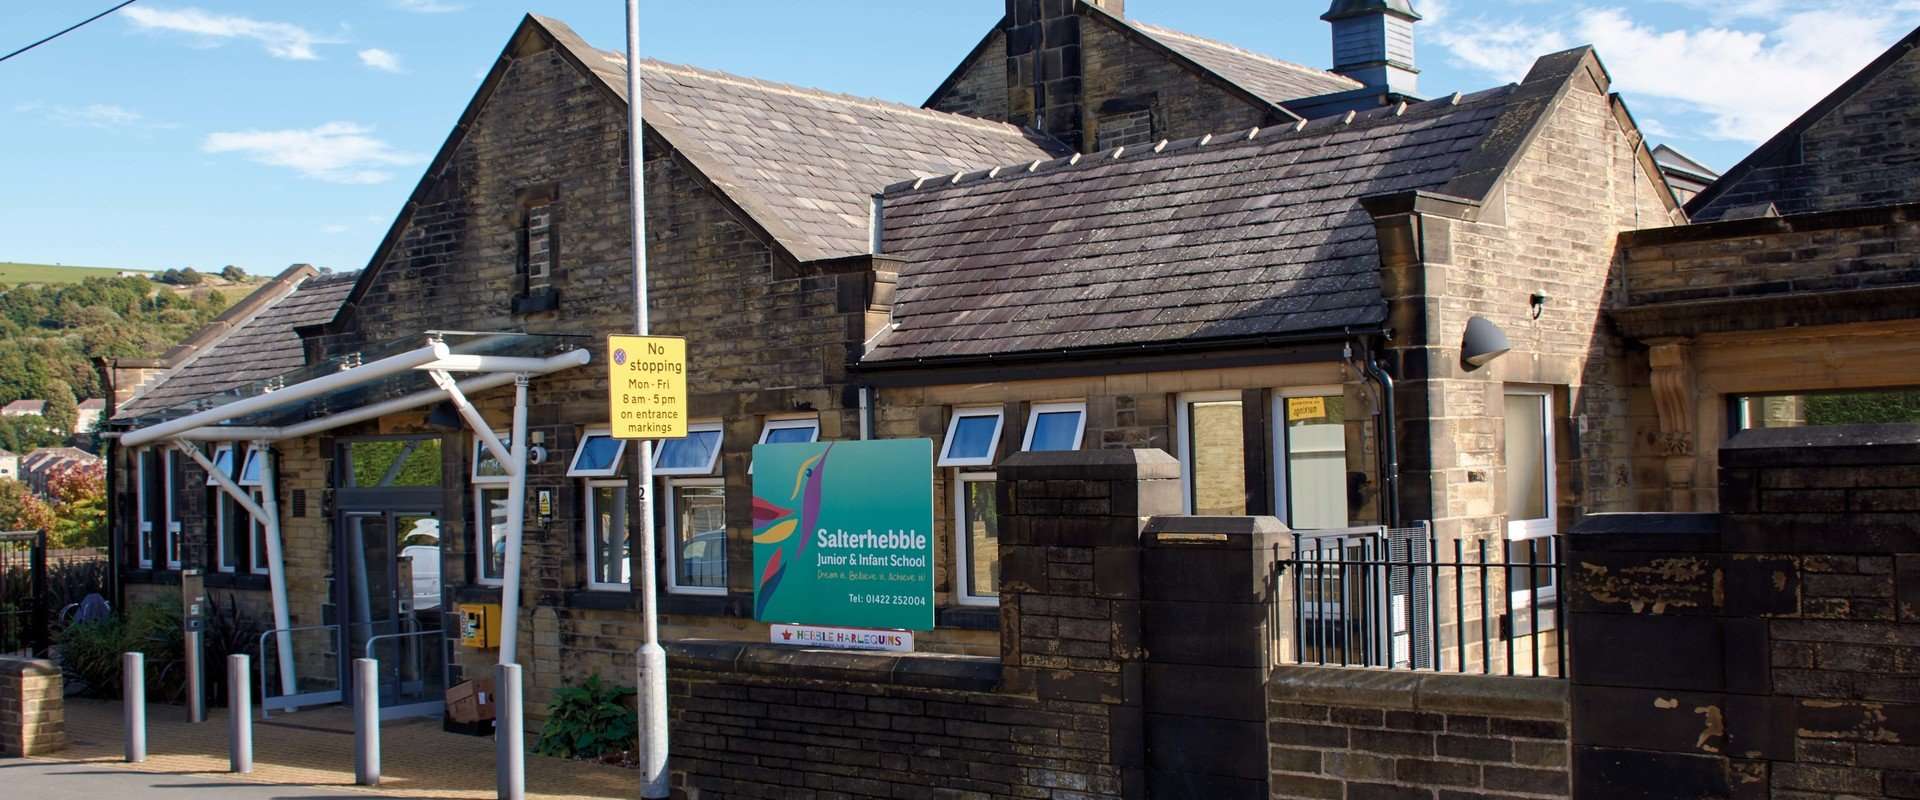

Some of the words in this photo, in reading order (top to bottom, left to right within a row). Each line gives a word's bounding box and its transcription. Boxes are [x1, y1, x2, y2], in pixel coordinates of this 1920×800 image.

[648, 342, 665, 355] No
[630, 360, 682, 374] stopping
[628, 379, 650, 390] Mon
[657, 379, 670, 389] Fri
[620, 411, 633, 419] on
[636, 409, 679, 419] entrance
[628, 421, 672, 434] markings
[817, 528, 926, 549] Salterhebble
[817, 553, 848, 567] Junior
[849, 553, 857, 565] &
[859, 554, 888, 566] Infant
[890, 555, 926, 568] School
[848, 593, 863, 603] Tel:
[866, 594, 890, 604] 01422
[892, 595, 926, 606] 252004
[797, 630, 833, 642] HEBBLE
[837, 632, 902, 646] HARLEQUINS
